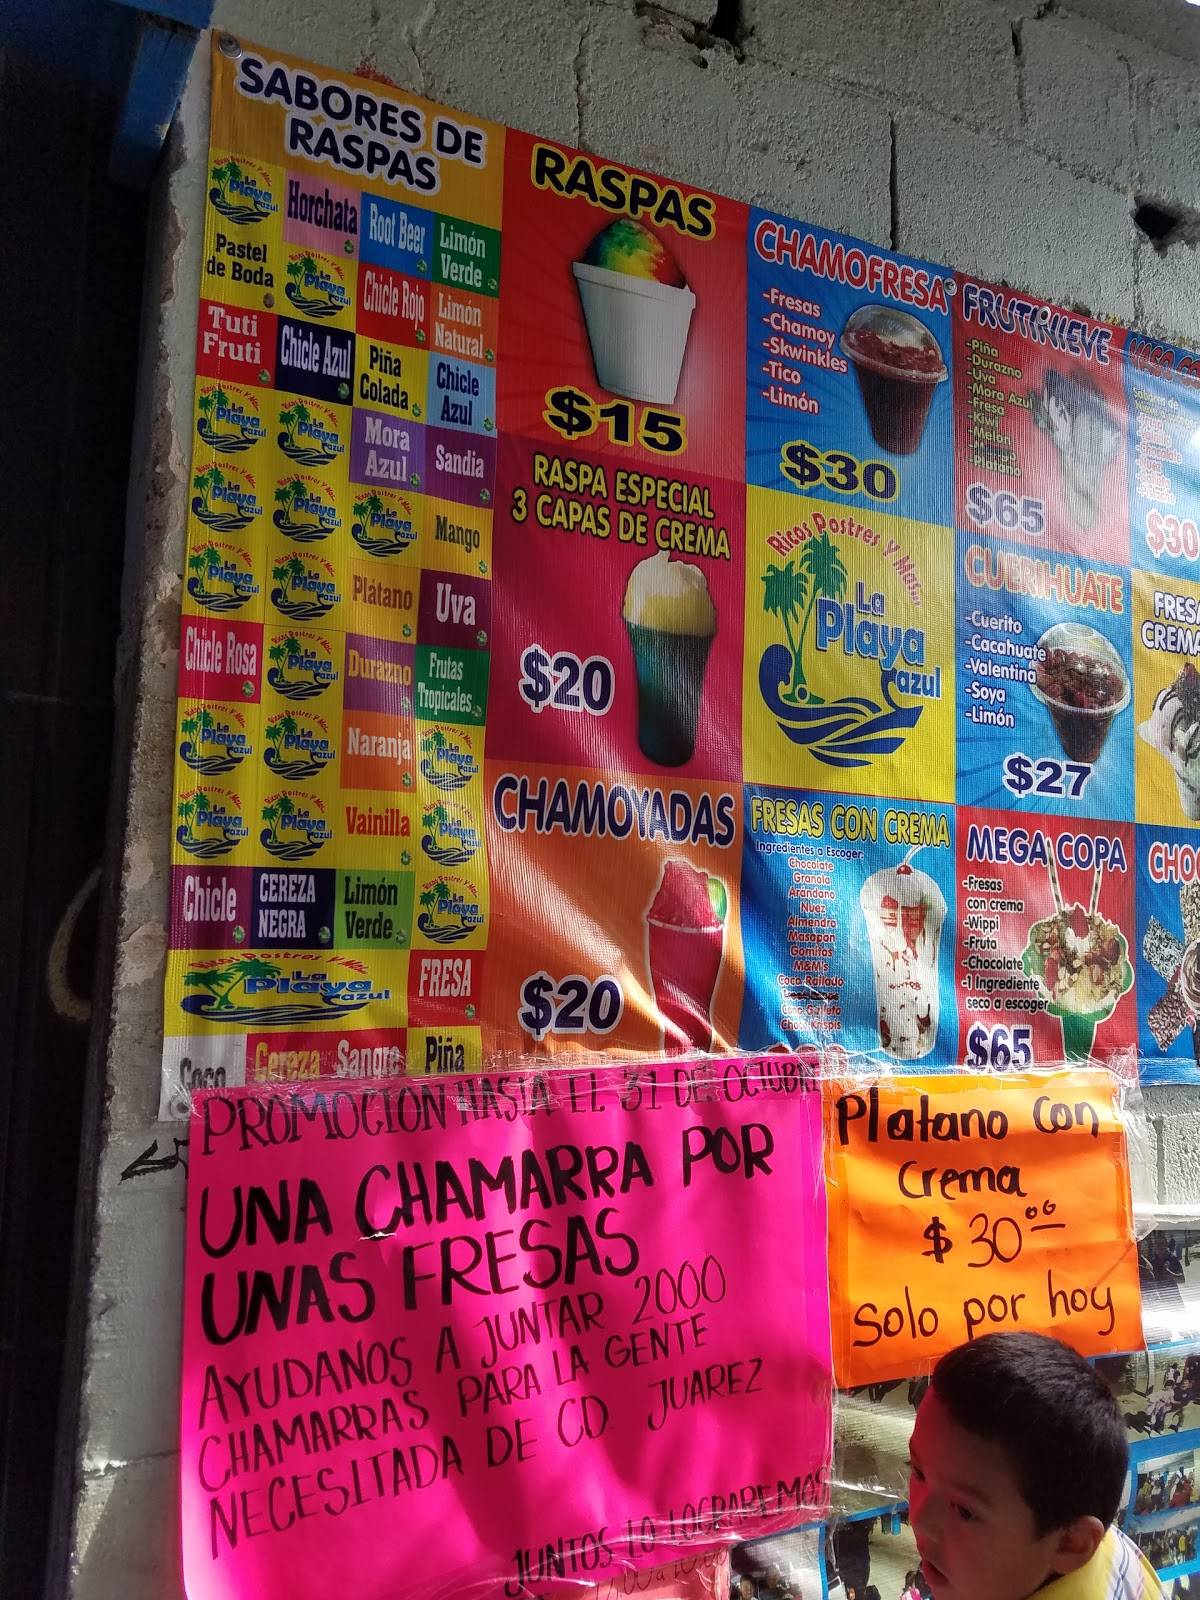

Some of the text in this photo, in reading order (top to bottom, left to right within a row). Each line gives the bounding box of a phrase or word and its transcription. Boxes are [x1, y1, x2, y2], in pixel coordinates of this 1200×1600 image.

[238, 57, 485, 165] SABORES DE
[287, 116, 438, 191] RASPAS
[286, 179, 359, 235] Horchata
[534, 146, 714, 238] RASPAS
[368, 203, 426, 255] Root Beer
[438, 222, 487, 258] Limón
[215, 233, 268, 263] Pastel
[206, 256, 275, 288] de Boda
[440, 252, 482, 288] Verde
[755, 220, 949, 315] CHAMOFRESA
[363, 270, 426, 331] Chicle Rojo
[438, 292, 482, 328] Limón
[762, 287, 822, 318] -Fresas
[207, 305, 258, 337] Tuti
[762, 312, 836, 350] -Chamoy
[962, 281, 1114, 366] FRUTINIEVE
[202, 331, 261, 364] Fruti
[280, 324, 352, 380] Chicle Azul
[369, 344, 403, 379] Piña
[433, 330, 484, 360] Natural
[762, 336, 849, 374] -Skwinkles
[966, 338, 998, 358] -Piña
[435, 361, 481, 397] Chicle
[762, 361, 802, 386] -Tico
[966, 354, 1023, 380] -Durazno
[967, 368, 997, 386] -Uva
[359, 373, 410, 411] Colada
[762, 385, 820, 415] -Limón
[967, 383, 1034, 410] -Mora Azul
[967, 398, 1006, 417] -Fresa
[439, 399, 474, 426] Azul
[546, 388, 684, 453] $15
[364, 416, 411, 452] Mora
[364, 450, 408, 482] Azul
[435, 443, 485, 479] Sandia
[780, 441, 899, 501] $30
[533, 453, 716, 519] RASPA ESPECIAL
[511, 489, 732, 560] 3 CAPAS DE CREMA
[966, 482, 1045, 535] $65
[435, 515, 481, 553] Mango
[766, 511, 882, 557] Ricos Postres
[1145, 508, 1199, 559] $30
[351, 574, 413, 611] Plátano
[435, 582, 477, 626] Uva
[855, 580, 886, 616] La
[815, 596, 926, 670] Playa
[964, 610, 1024, 634] -Cuerito
[184, 625, 223, 674] Chicle
[226, 631, 258, 676] Rosa
[428, 651, 465, 681] Frutas
[964, 634, 1047, 662] -Cacahuate
[347, 649, 413, 687] Durazno
[521, 648, 613, 712] $20
[896, 667, 942, 699] azul
[964, 657, 1038, 685] -Valentina
[417, 681, 474, 716] Tropicales
[964, 682, 1007, 706] -Soya
[964, 705, 1016, 729] -Limón
[347, 727, 413, 765] Naranja
[1004, 753, 1093, 799] $27
[345, 805, 411, 838] Vainilla
[494, 775, 735, 847] CHAMOYADAS
[751, 797, 951, 848] FRESAS CON CREMA
[755, 841, 865, 860] Ingredientes Escoger:
[788, 857, 834, 871] Chocolate
[966, 825, 1128, 873] MEGA COPA
[259, 873, 316, 903] CEREZA
[343, 875, 399, 907] Limón
[792, 872, 832, 885] Granola
[963, 876, 1003, 892] -Fresas
[182, 875, 237, 923] Chicle
[800, 902, 826, 914] Nuez
[967, 898, 1024, 913] con crema
[258, 908, 307, 939] NEGRA
[344, 911, 394, 940] Verde
[787, 915, 838, 928] Almendra
[787, 931, 836, 944] Masapan
[964, 915, 1000, 933] -Wippi
[790, 945, 833, 957] Gomitas
[963, 936, 998, 951] -Fruta
[418, 958, 472, 998] FRESA
[793, 960, 829, 972] M&M's
[805, 975, 845, 987] Rallado
[963, 955, 1024, 972] -Chocolate
[974, 975, 1040, 993] Ingrediente
[520, 974, 622, 1037] $20
[967, 998, 1049, 1012] seco escoger
[254, 1039, 400, 1082] Cereza Sangre
[425, 1035, 466, 1073] Piña
[967, 1024, 1032, 1073] $65
[201, 1084, 446, 1156] PROMOCION
[453, 1071, 551, 1127] HASTA
[568, 1072, 606, 1115] EL
[620, 1068, 661, 1112] 31
[673, 1064, 711, 1108] DE
[835, 1087, 1009, 1146] Platano
[199, 1123, 775, 1259] UNA CHAMARRA POR
[200, 1207, 641, 1345] UNAS FRESAS
[963, 1269, 1115, 1340] por hoy
[198, 1255, 727, 1430] AYUDANOS A JUNTAR 2000
[198, 1313, 709, 1492] CHAMARRAS PARA LA GENTE
[210, 1435, 465, 1561] NECESITADA
[485, 1418, 537, 1468] DE
[647, 1358, 763, 1432] JUAREZ
[504, 1526, 615, 1599] JUNTOS
[627, 1516, 657, 1559] LO
